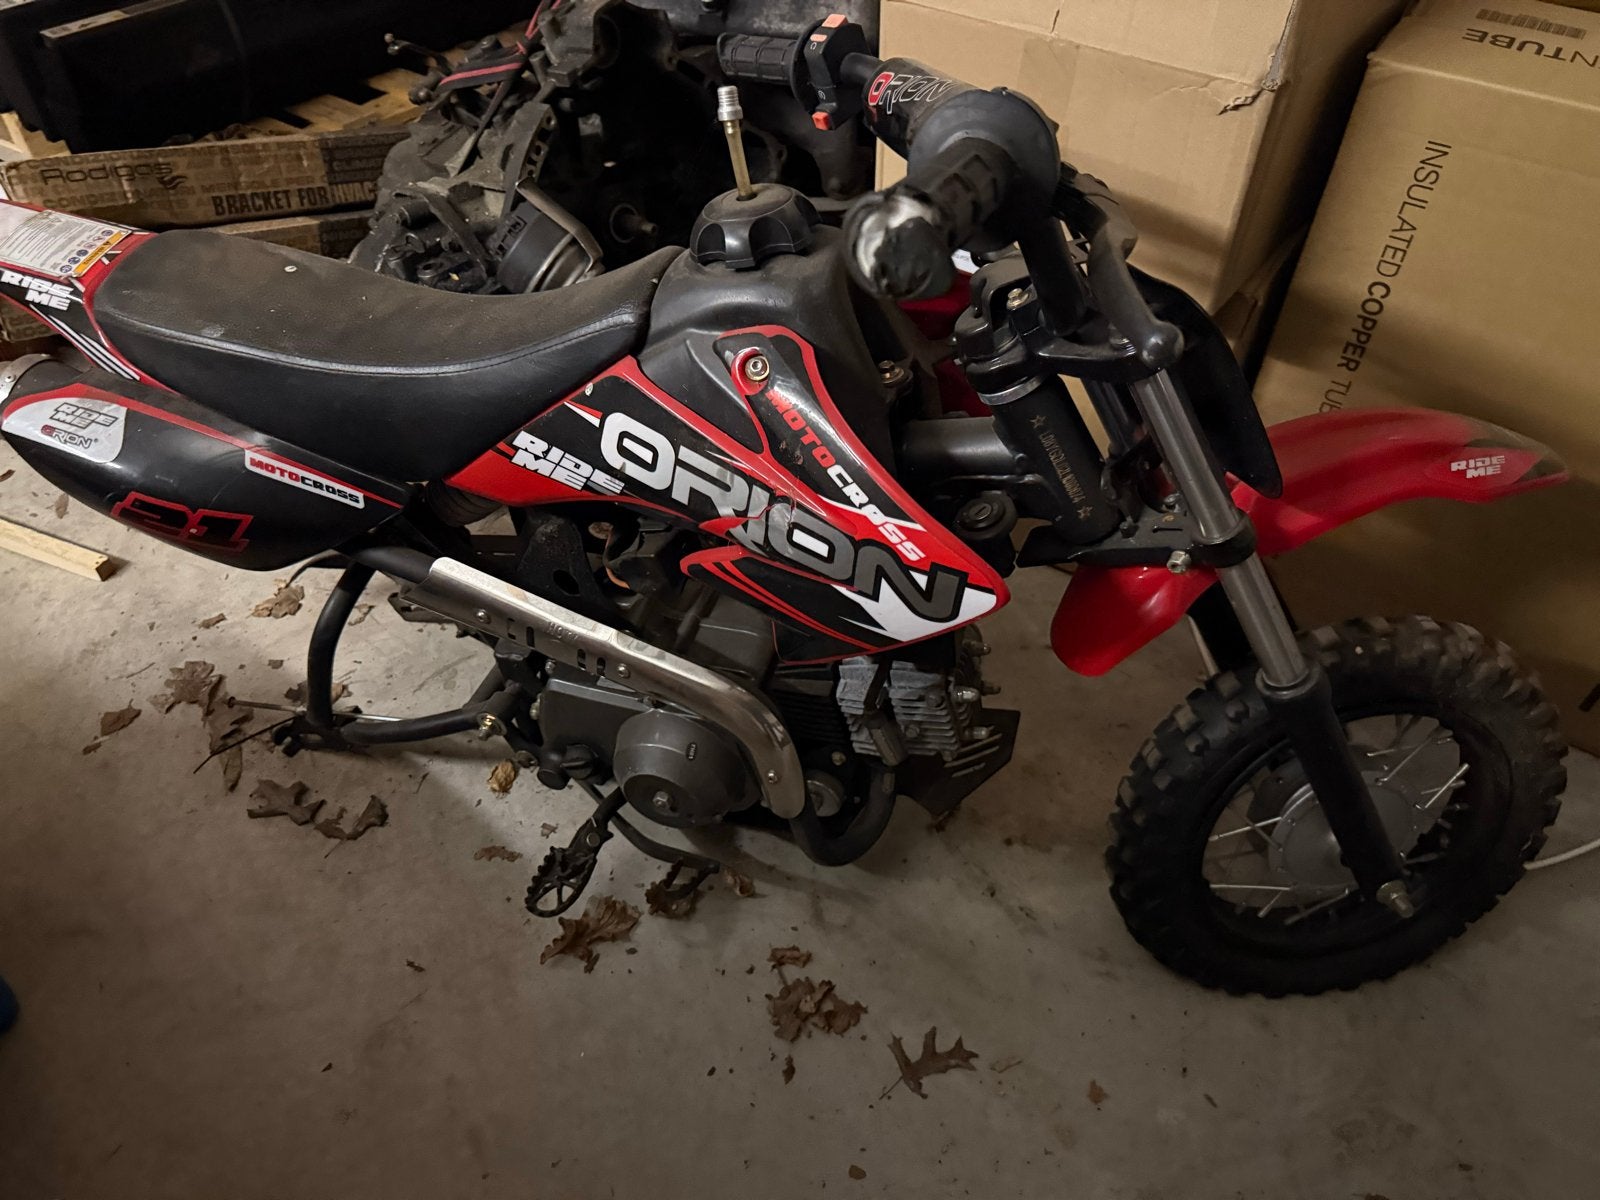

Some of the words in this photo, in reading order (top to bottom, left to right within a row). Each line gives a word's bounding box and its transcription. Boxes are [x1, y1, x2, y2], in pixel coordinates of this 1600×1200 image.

[1462, 28, 1600, 67] NTUBE
[211, 188, 293, 217] BRACKET
[297, 186, 329, 208] FOR
[330, 181, 377, 205] HVAC
[1375, 139, 1453, 278] INSULATED
[0, 270, 74, 298] RIDE
[25, 289, 71, 311] ME
[1337, 281, 1391, 372] COPPER
[49, 411, 93, 429] ME
[54, 402, 118, 427] RIDE
[250, 457, 360, 504] MOTOCROSS
[511, 448, 588, 491] ME
[512, 430, 625, 494] RIDE
[765, 388, 926, 561] MOTOCROSS
[1450, 455, 1505, 472] RIDE
[1466, 465, 1501, 479] ME
[600, 411, 966, 622] ORION
